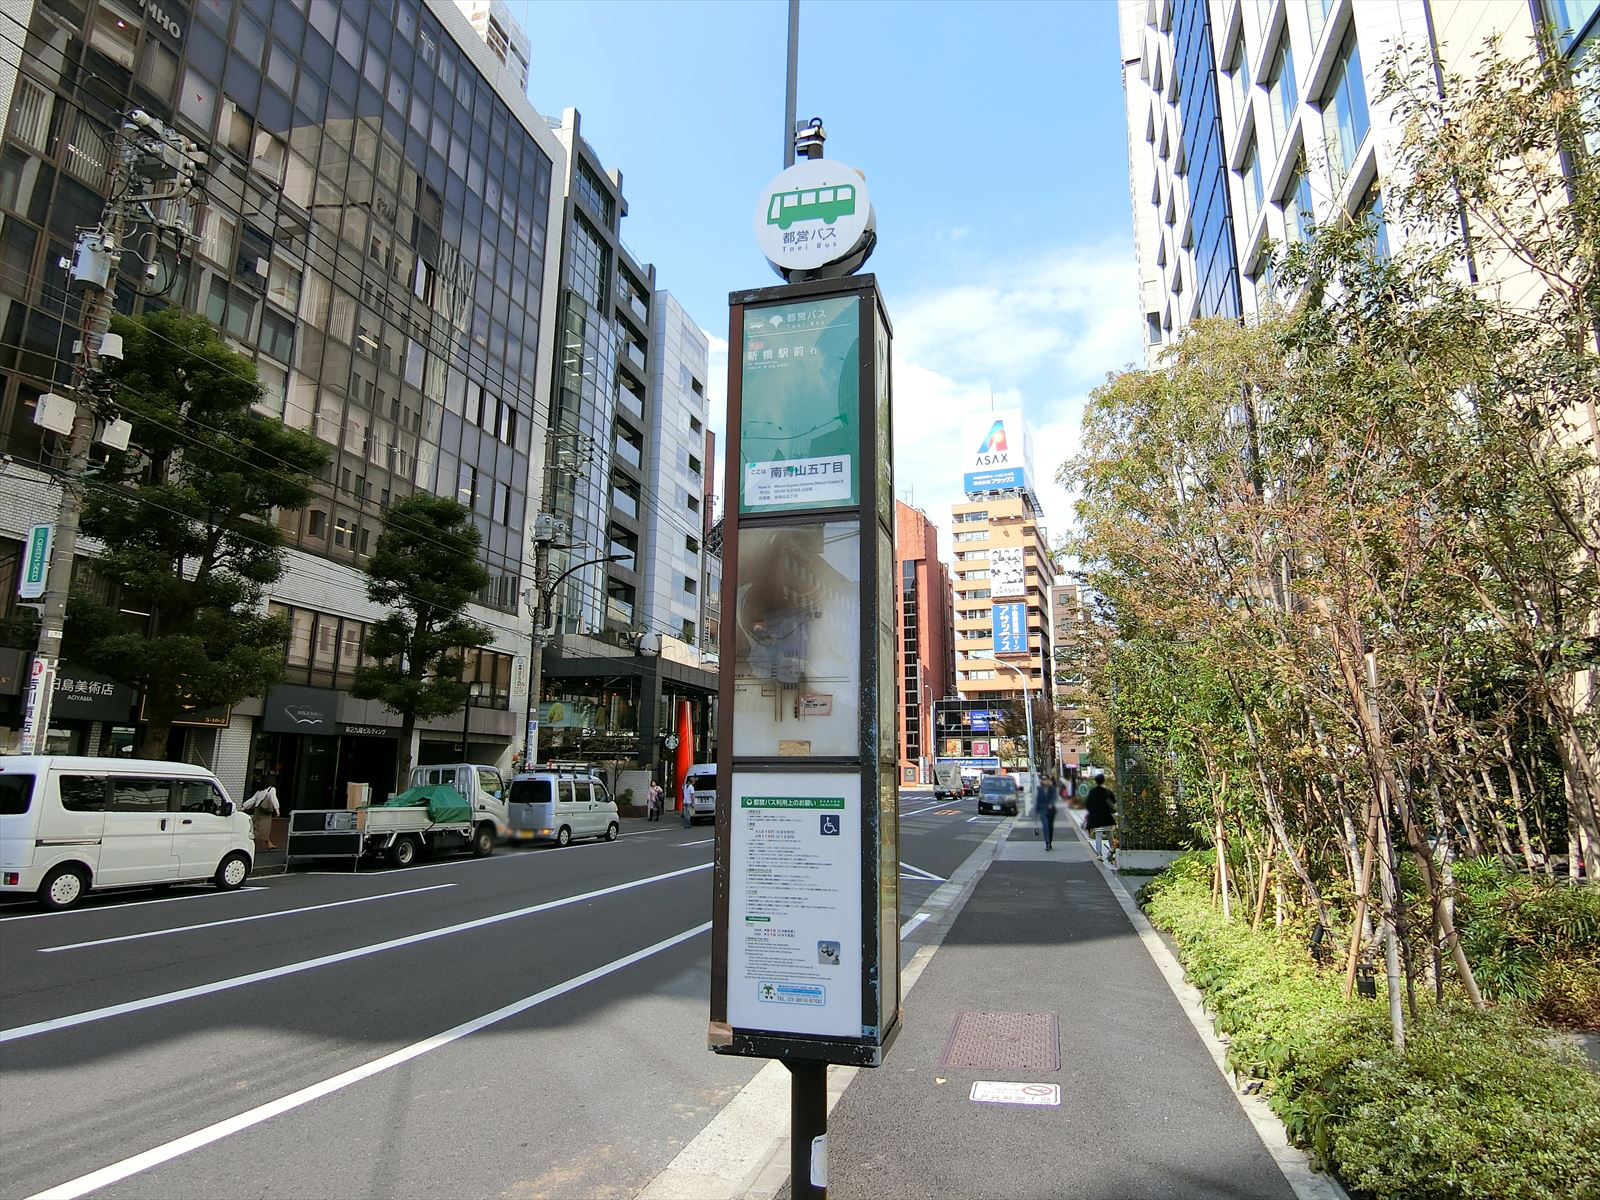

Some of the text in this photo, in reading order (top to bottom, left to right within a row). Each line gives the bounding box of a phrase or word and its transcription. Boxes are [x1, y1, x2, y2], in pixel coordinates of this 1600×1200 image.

[783, 227, 837, 245] 都営バス
[787, 309, 826, 323] 都営バス
[747, 345, 804, 361] 新橋駅前
[975, 453, 1008, 466] ASAX
[770, 461, 843, 479] 南青山五丁目
[34, 537, 44, 562] GREEN
[31, 562, 41, 581] SEED
[999, 605, 1011, 651] アサックス
[67, 694, 93, 702] AOYAMA
